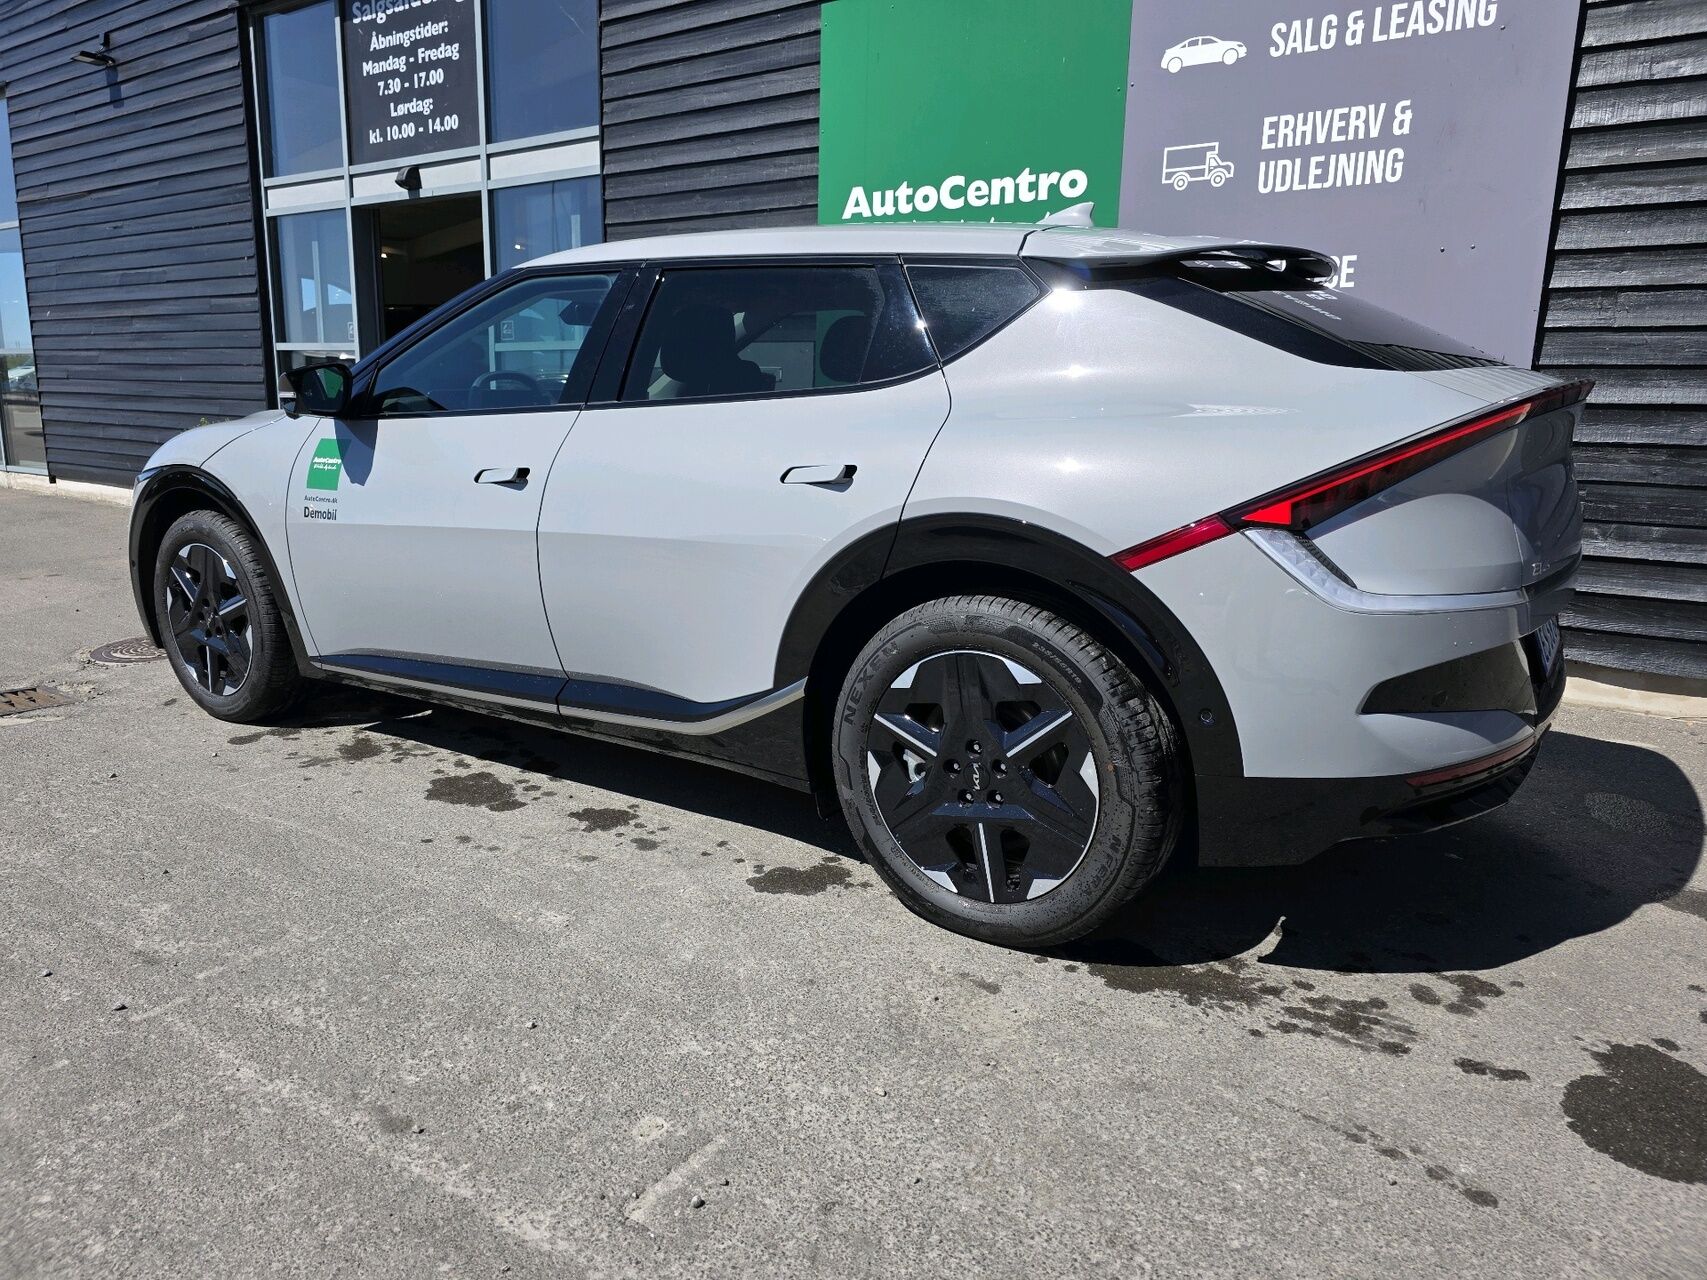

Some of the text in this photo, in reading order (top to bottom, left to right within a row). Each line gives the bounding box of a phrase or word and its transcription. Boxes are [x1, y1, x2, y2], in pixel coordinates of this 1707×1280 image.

[370, 21, 448, 51] Åbningstider:
[1269, 0, 1498, 57] SALG & LEASING
[362, 55, 407, 77] Mandag
[417, 43, 460, 64] Fredag
[377, 77, 401, 96] 7.30
[413, 68, 445, 88] 17.00
[389, 97, 434, 117] Lørdag:
[369, 128, 384, 144] kl.
[386, 121, 415, 141] 10.00
[428, 113, 459, 134] 14.00
[1261, 99, 1413, 151] ERHVERV &
[1257, 147, 1405, 194] UDLEJNING
[841, 167, 1089, 220] AutoCentro
[304, 507, 337, 520] Demobil
